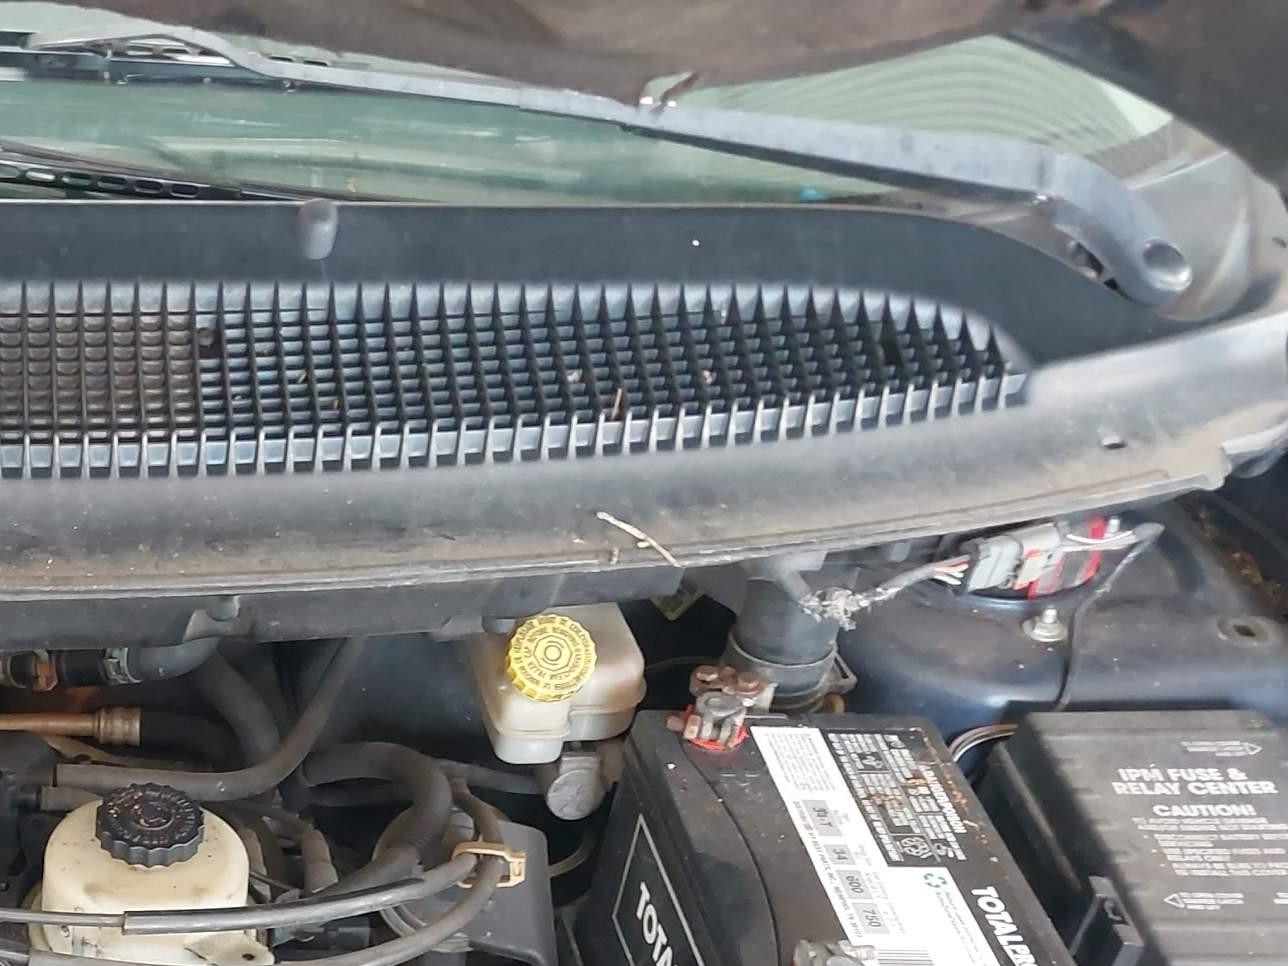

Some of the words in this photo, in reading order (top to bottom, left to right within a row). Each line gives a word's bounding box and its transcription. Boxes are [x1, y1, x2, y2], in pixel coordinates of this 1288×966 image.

[1167, 768, 1224, 781] FUSE
[1226, 768, 1248, 781] &
[1112, 781, 1181, 795] RELAY
[1187, 780, 1279, 794] CENTER
[1152, 804, 1258, 817] CAUTION!
[845, 875, 864, 894] 600
[861, 908, 883, 927] 750
